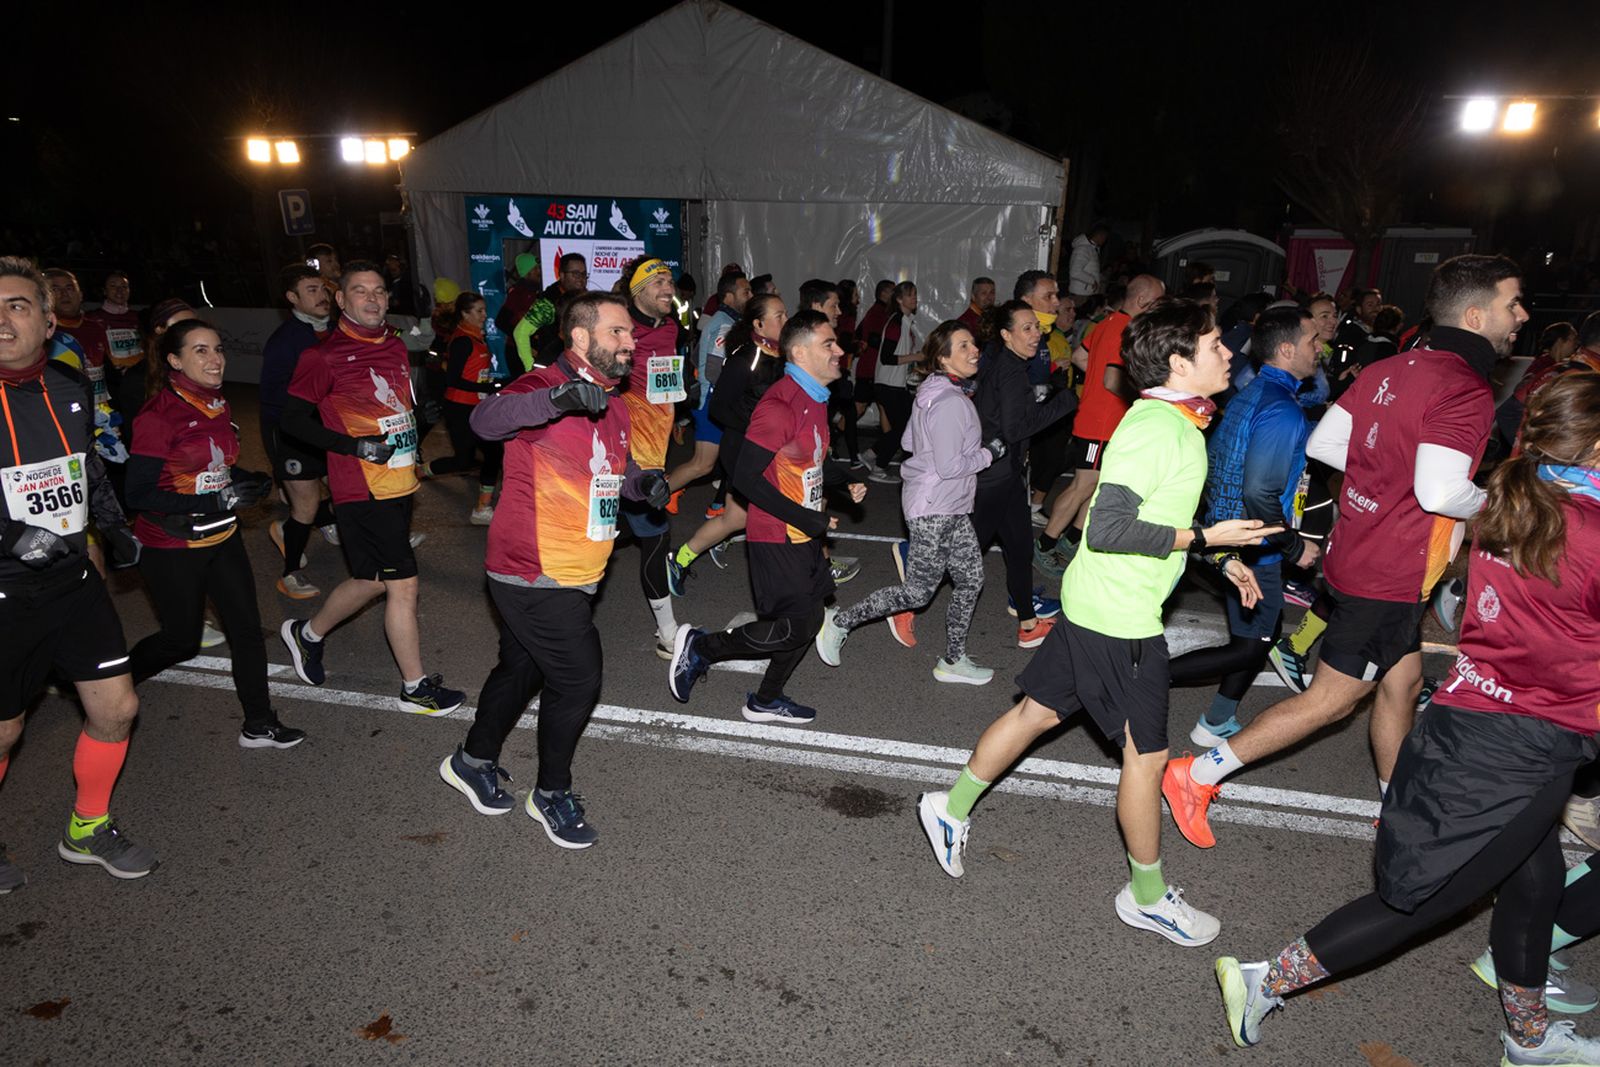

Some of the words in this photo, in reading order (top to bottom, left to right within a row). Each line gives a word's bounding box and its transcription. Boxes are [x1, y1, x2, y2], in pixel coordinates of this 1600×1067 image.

[543, 217, 596, 236] ANTÓN
[618, 222, 628, 234] 43
[593, 256, 618, 268] SAN
[655, 372, 678, 388] 6810
[26, 469, 52, 481] NOCHE
[53, 467, 62, 475] DE
[17, 483, 37, 493] SAN
[26, 482, 83, 515] 3566
